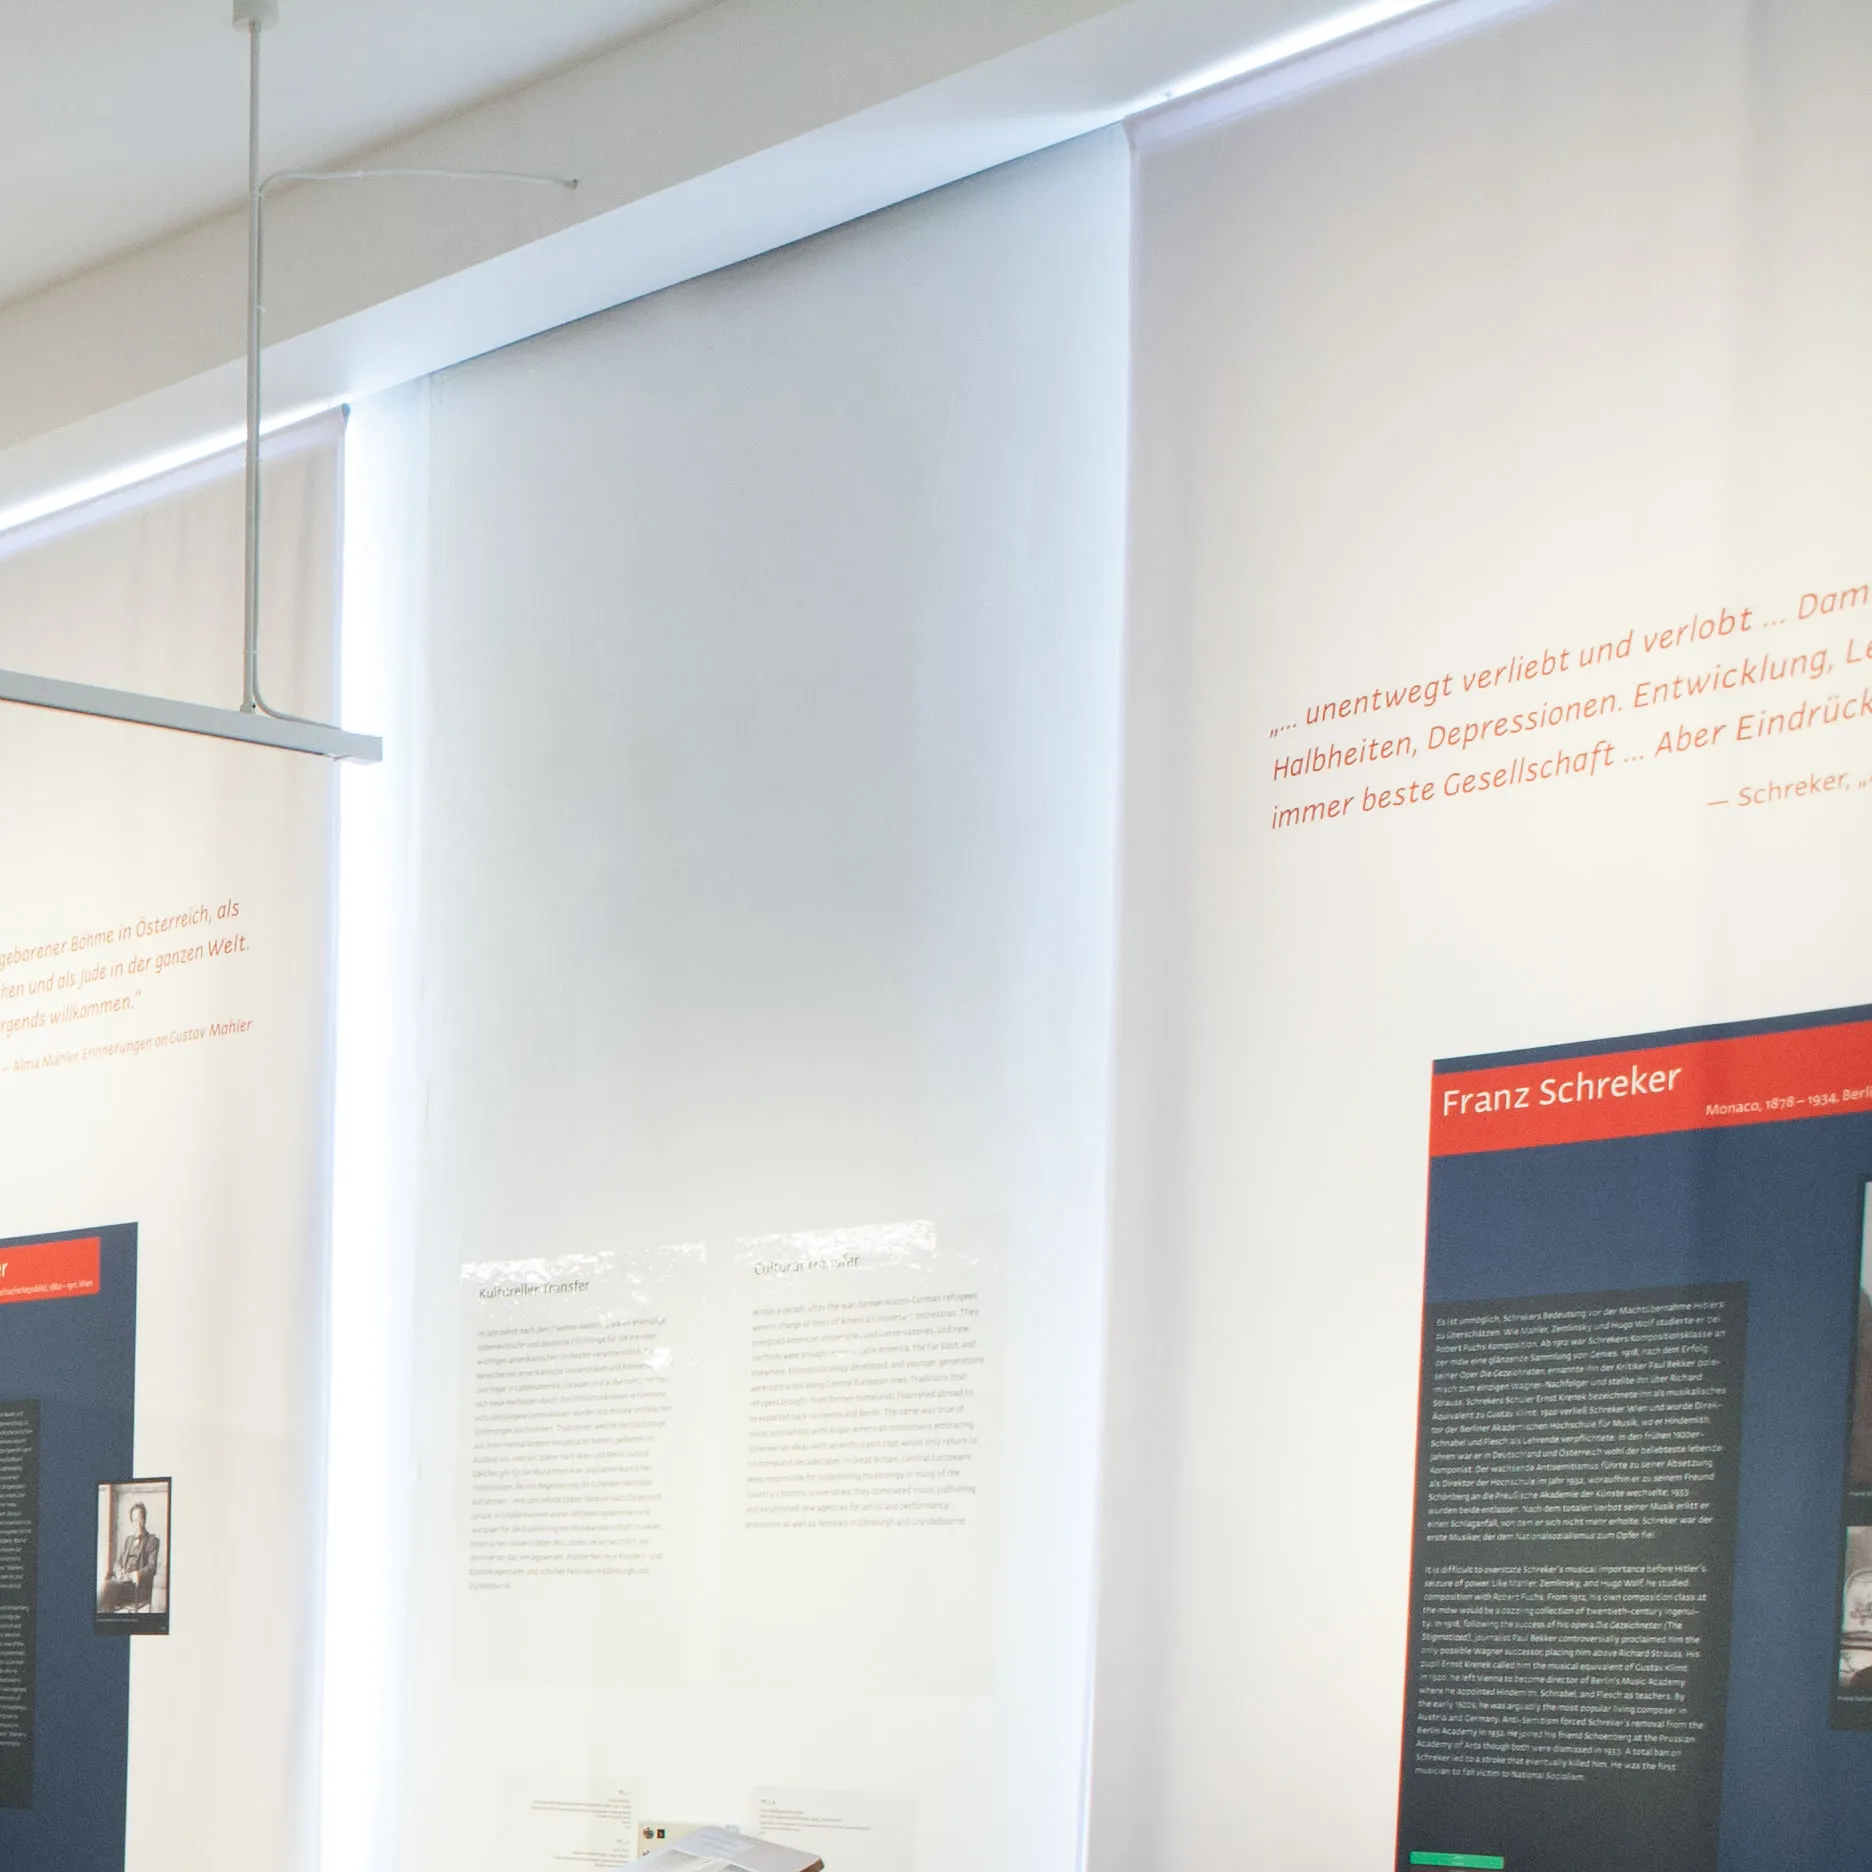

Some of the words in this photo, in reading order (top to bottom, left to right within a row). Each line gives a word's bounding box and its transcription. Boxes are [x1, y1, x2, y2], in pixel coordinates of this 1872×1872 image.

[1305, 673, 1453, 725] unentwegt
[1462, 648, 1570, 692] verliebt
[1579, 629, 1634, 668] und
[1643, 607, 1753, 653] verlobt
[1797, 584, 1869, 620] Dam
[1272, 735, 1417, 782] Halbheiten,
[1427, 693, 1622, 751] Depressionen.
[1633, 649, 1833, 708] Entwicklung,
[1271, 795, 1355, 830] immer
[1361, 780, 1435, 812] beste
[1443, 739, 1615, 797] Gesellschaft
[1654, 723, 1727, 757] Aber
[1737, 772, 1850, 807] Schreker,
[70, 929, 114, 953] Böhme
[117, 925, 132, 941] in
[135, 903, 212, 935] Österreich,
[216, 897, 240, 920] als
[28, 973, 55, 995] und
[57, 970, 76, 989] als
[77, 964, 106, 990] Jude
[110, 962, 124, 977] in
[127, 955, 152, 975] der
[154, 944, 204, 974] ganzen
[207, 932, 250, 957] Welt.
[1443, 1086, 1530, 1117] Franz
[1538, 1066, 1682, 1106] Schreker
[1704, 1101, 1762, 1116] Monaco,
[1764, 1095, 1795, 1110] 1878
[1807, 1092, 1840, 1107] 1934,
